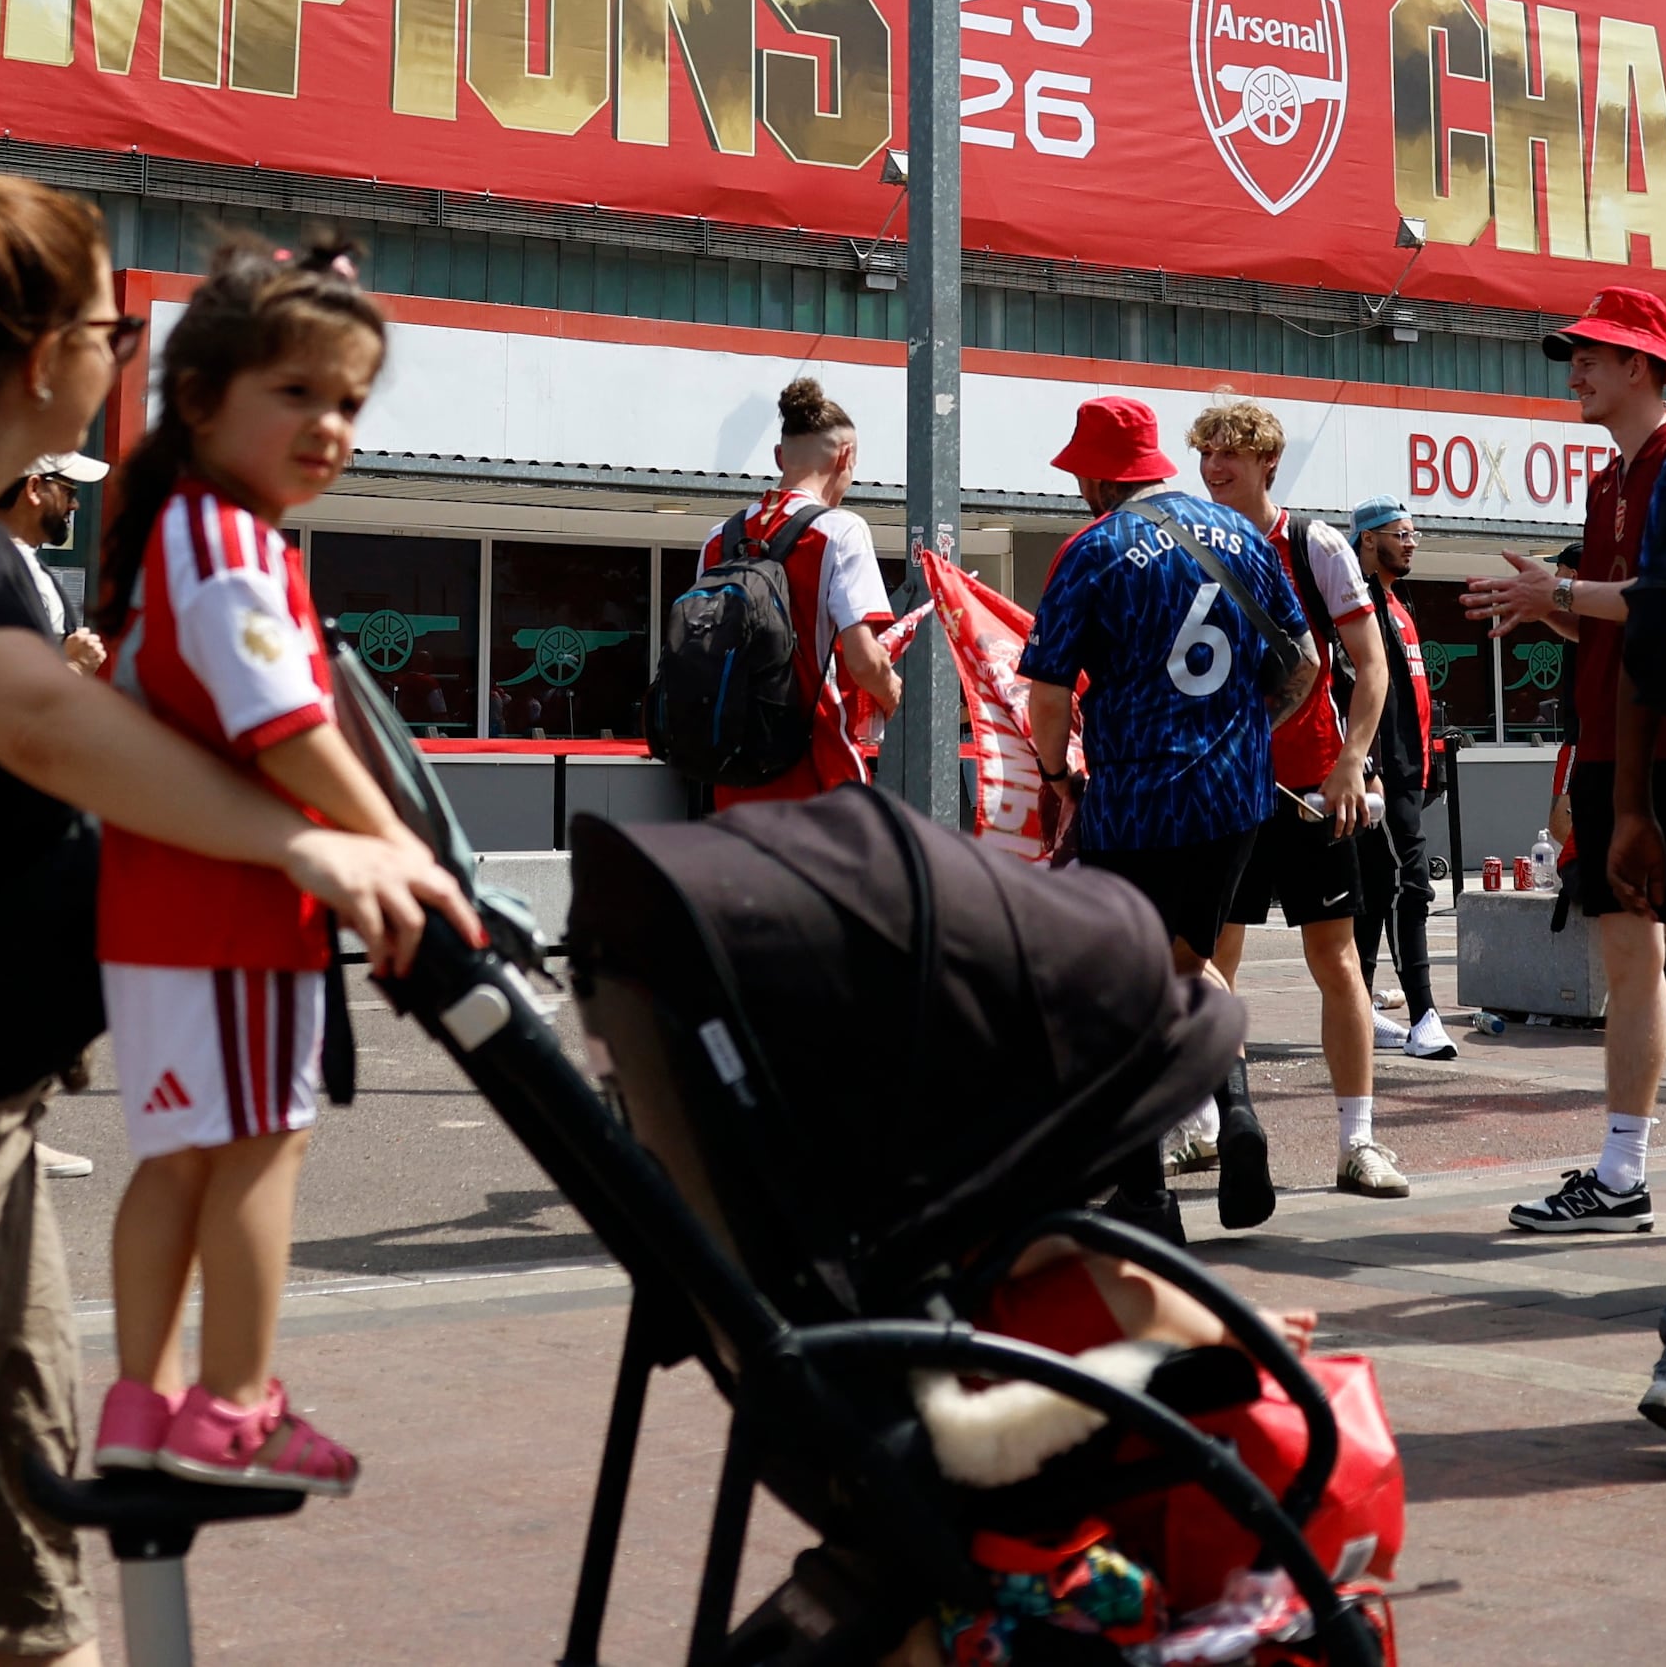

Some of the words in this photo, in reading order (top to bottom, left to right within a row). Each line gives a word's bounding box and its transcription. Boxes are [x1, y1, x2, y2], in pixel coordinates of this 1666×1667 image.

[1213, 4, 1326, 55] Arsenal
[960, 58, 1096, 160] 26
[1408, 432, 1512, 504] BOX
[1125, 523, 1243, 570] BLOERS
[1166, 582, 1233, 697] 6
